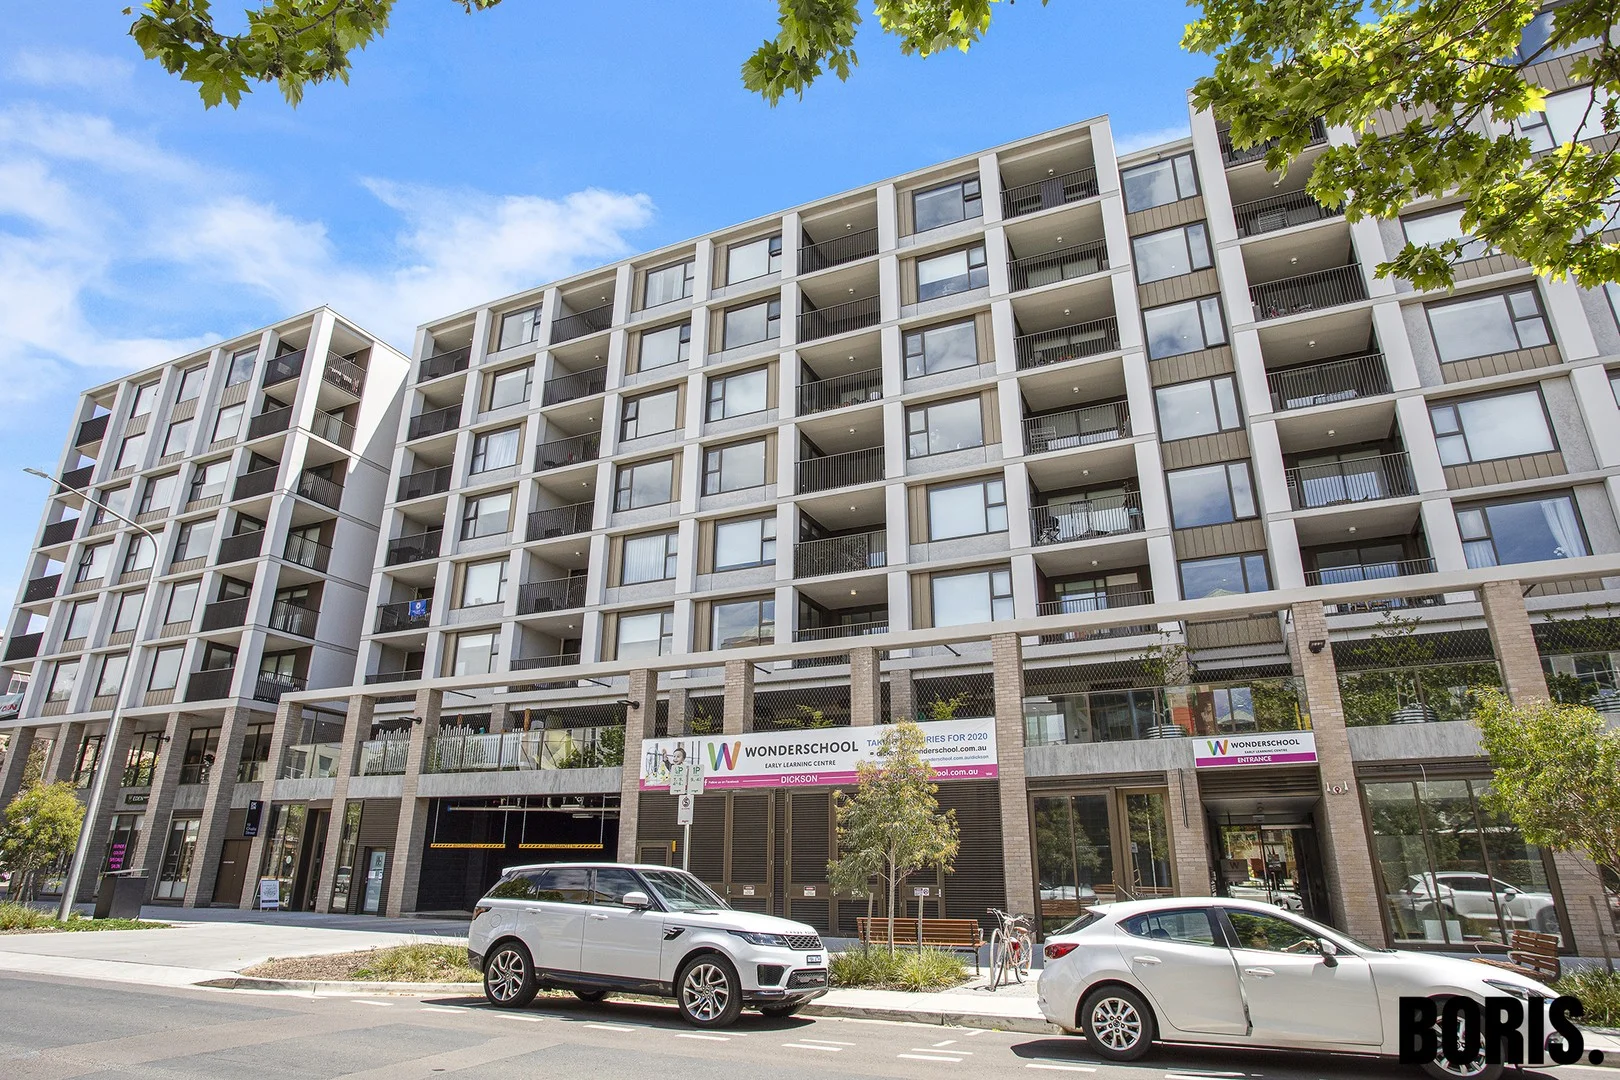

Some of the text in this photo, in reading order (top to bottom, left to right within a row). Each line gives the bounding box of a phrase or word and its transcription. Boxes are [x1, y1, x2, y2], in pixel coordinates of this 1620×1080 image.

[947, 734, 966, 742] FOR
[967, 732, 988, 741] 2020
[1231, 739, 1300, 749] WONDERSCHOOL
[745, 741, 859, 758] WONDERSCHOOL
[1237, 755, 1272, 764] ENTRANCE
[781, 774, 818, 784] DICKSON
